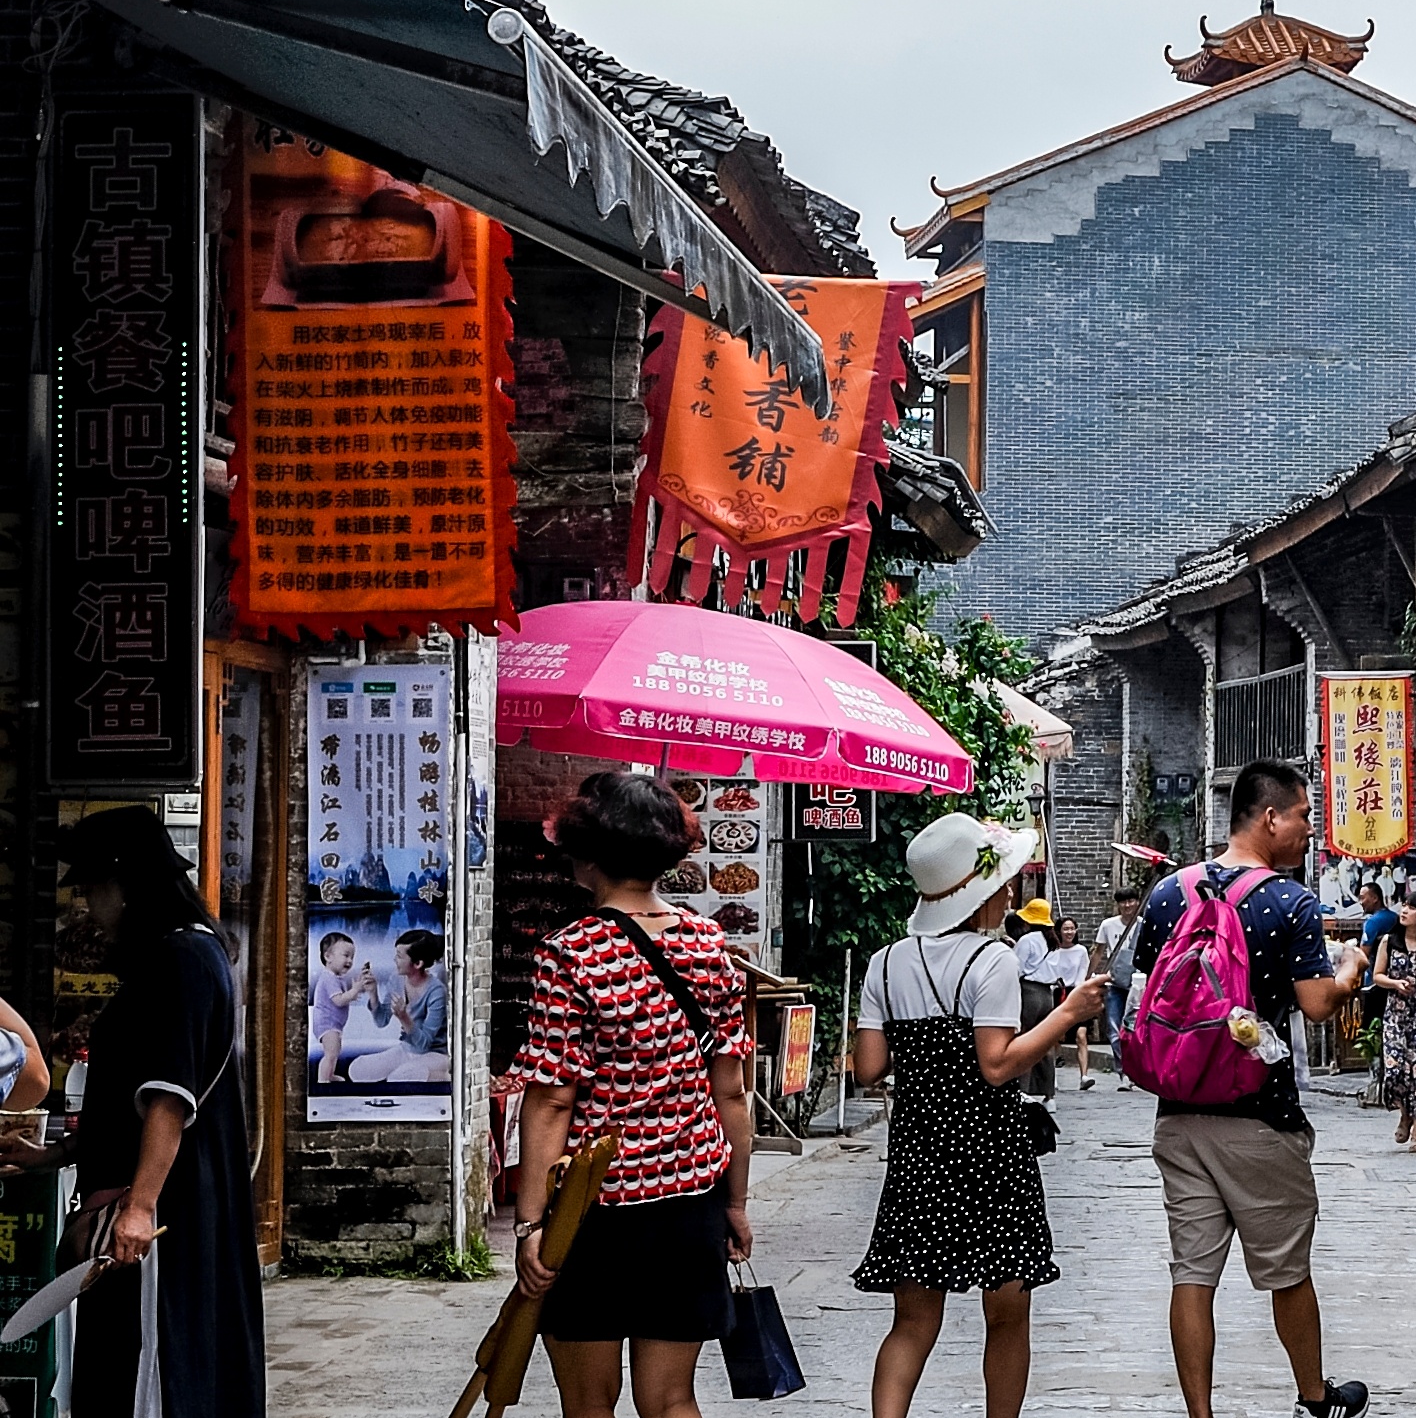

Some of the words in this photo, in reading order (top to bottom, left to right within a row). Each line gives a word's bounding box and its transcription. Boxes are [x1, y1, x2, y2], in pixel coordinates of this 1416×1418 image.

[72, 126, 174, 753] 古镇餐吧啤酒鱼
[646, 663, 769, 693] 美甲纹绣学校
[655, 650, 751, 677] 金希化妆
[632, 675, 672, 692] 188
[675, 682, 728, 700] 9056
[733, 691, 784, 708] 5110
[501, 699, 544, 719] 5110
[618, 707, 807, 751] 金希化妆美甲纹绣学校
[865, 745, 888, 767] 188
[889, 750, 919, 774] 9056
[919, 758, 949, 782] 5110
[803, 806, 864, 830] 啤酒鱼
